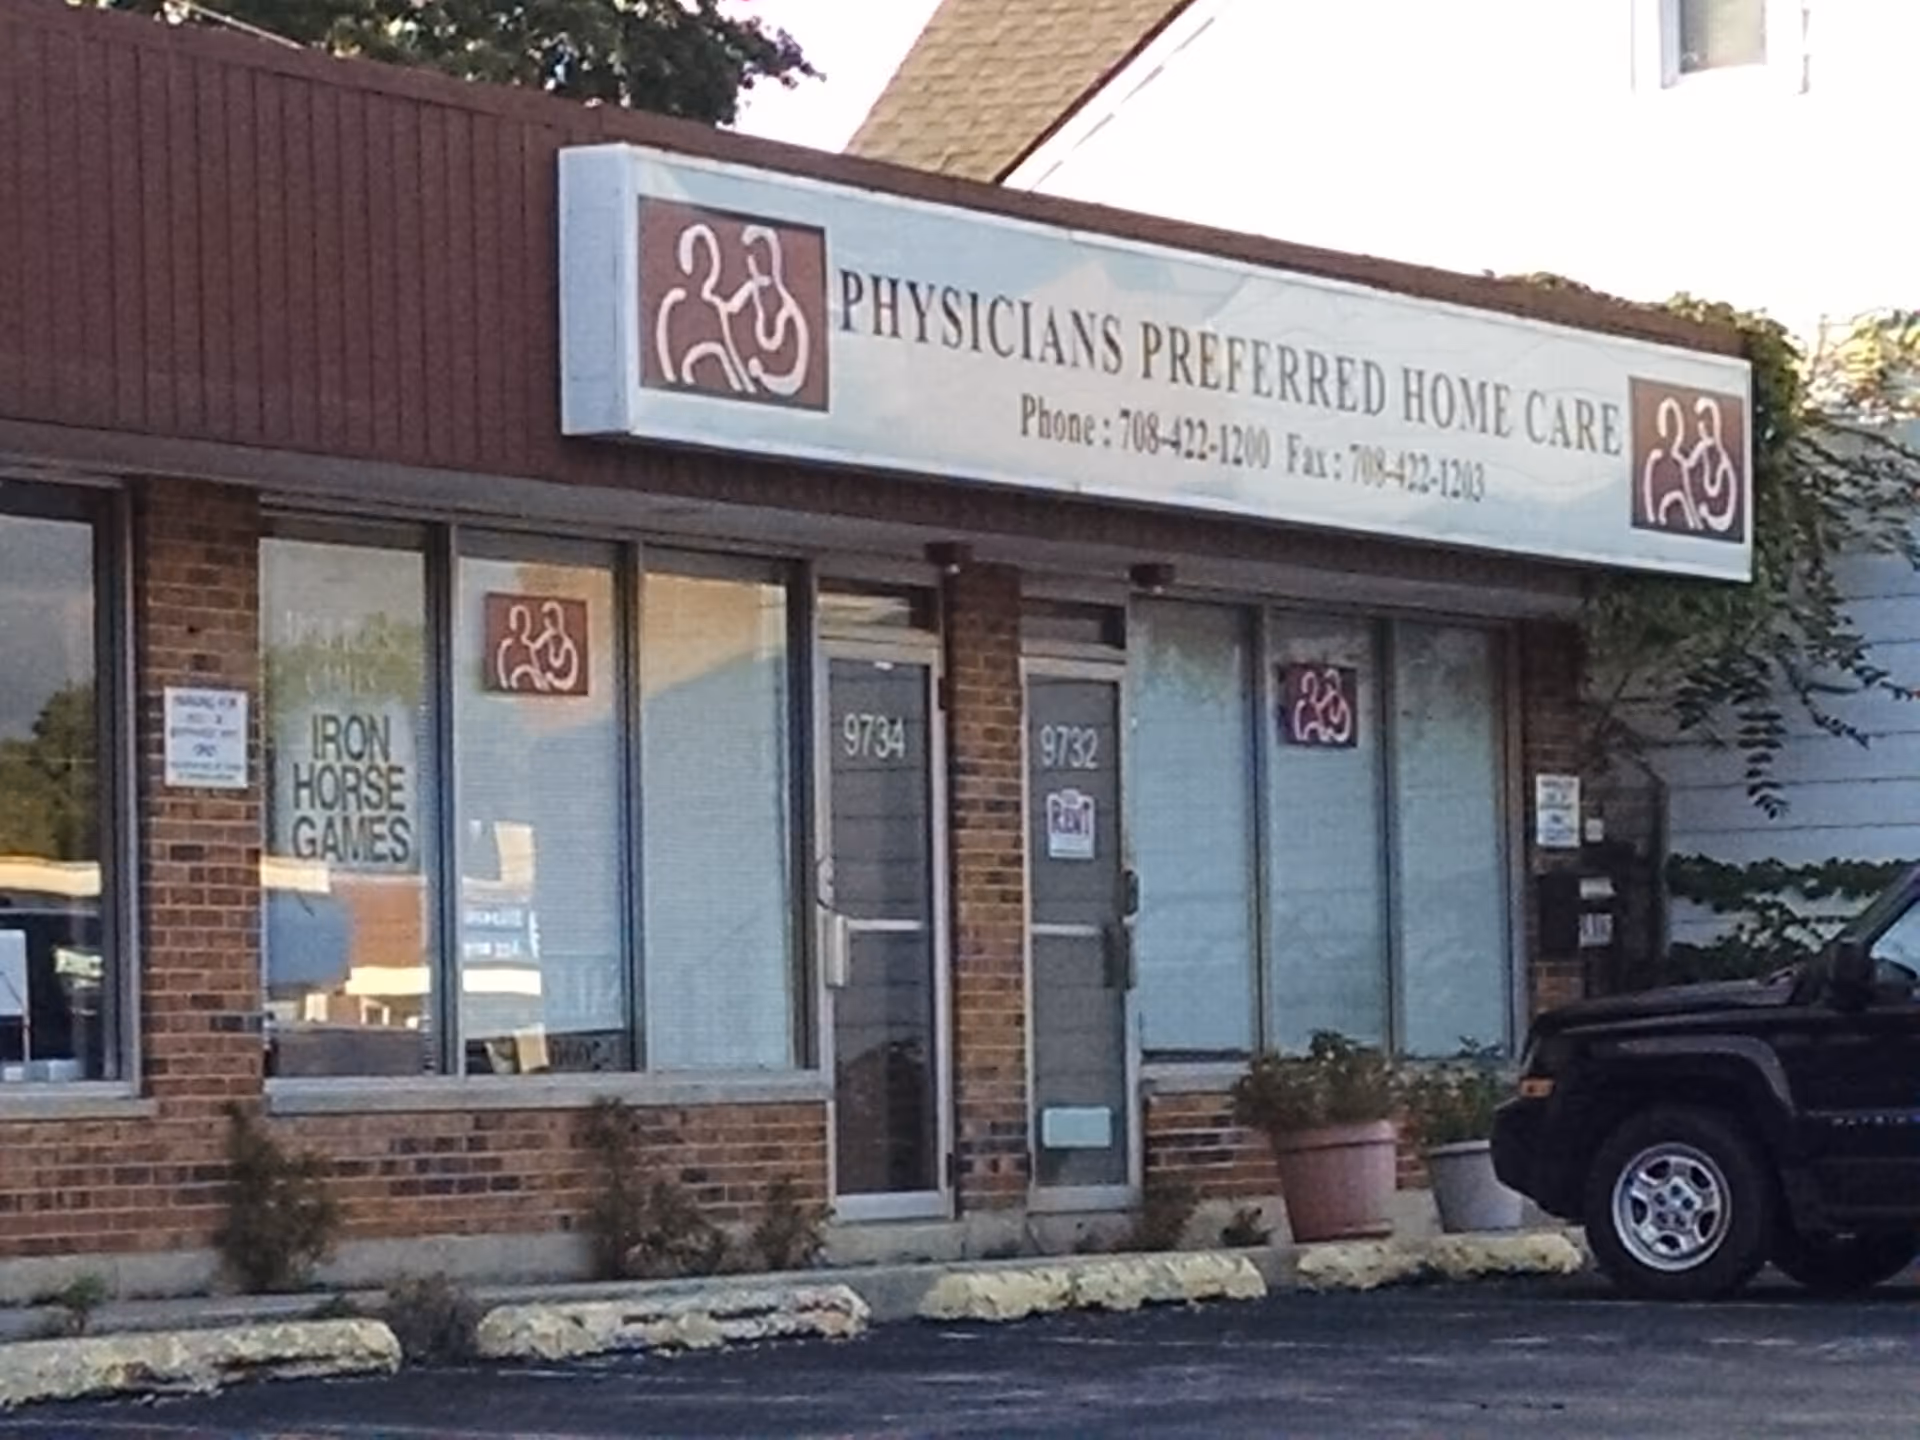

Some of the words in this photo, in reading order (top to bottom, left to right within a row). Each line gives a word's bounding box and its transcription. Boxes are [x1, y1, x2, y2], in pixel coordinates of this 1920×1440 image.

[838, 268, 1123, 376] PHYSICIANS
[1139, 320, 1386, 418] PREFERRED
[1401, 366, 1513, 439] HOME
[1525, 389, 1623, 457] CARE
[1119, 408, 1271, 471] 708-422-1200
[1349, 444, 1486, 502] 708-422-1203
[312, 714, 390, 762] IRON
[843, 713, 906, 759] 9734
[1039, 724, 1099, 770] 9732
[293, 763, 406, 812] HORSE
[292, 815, 411, 865] GAMES
